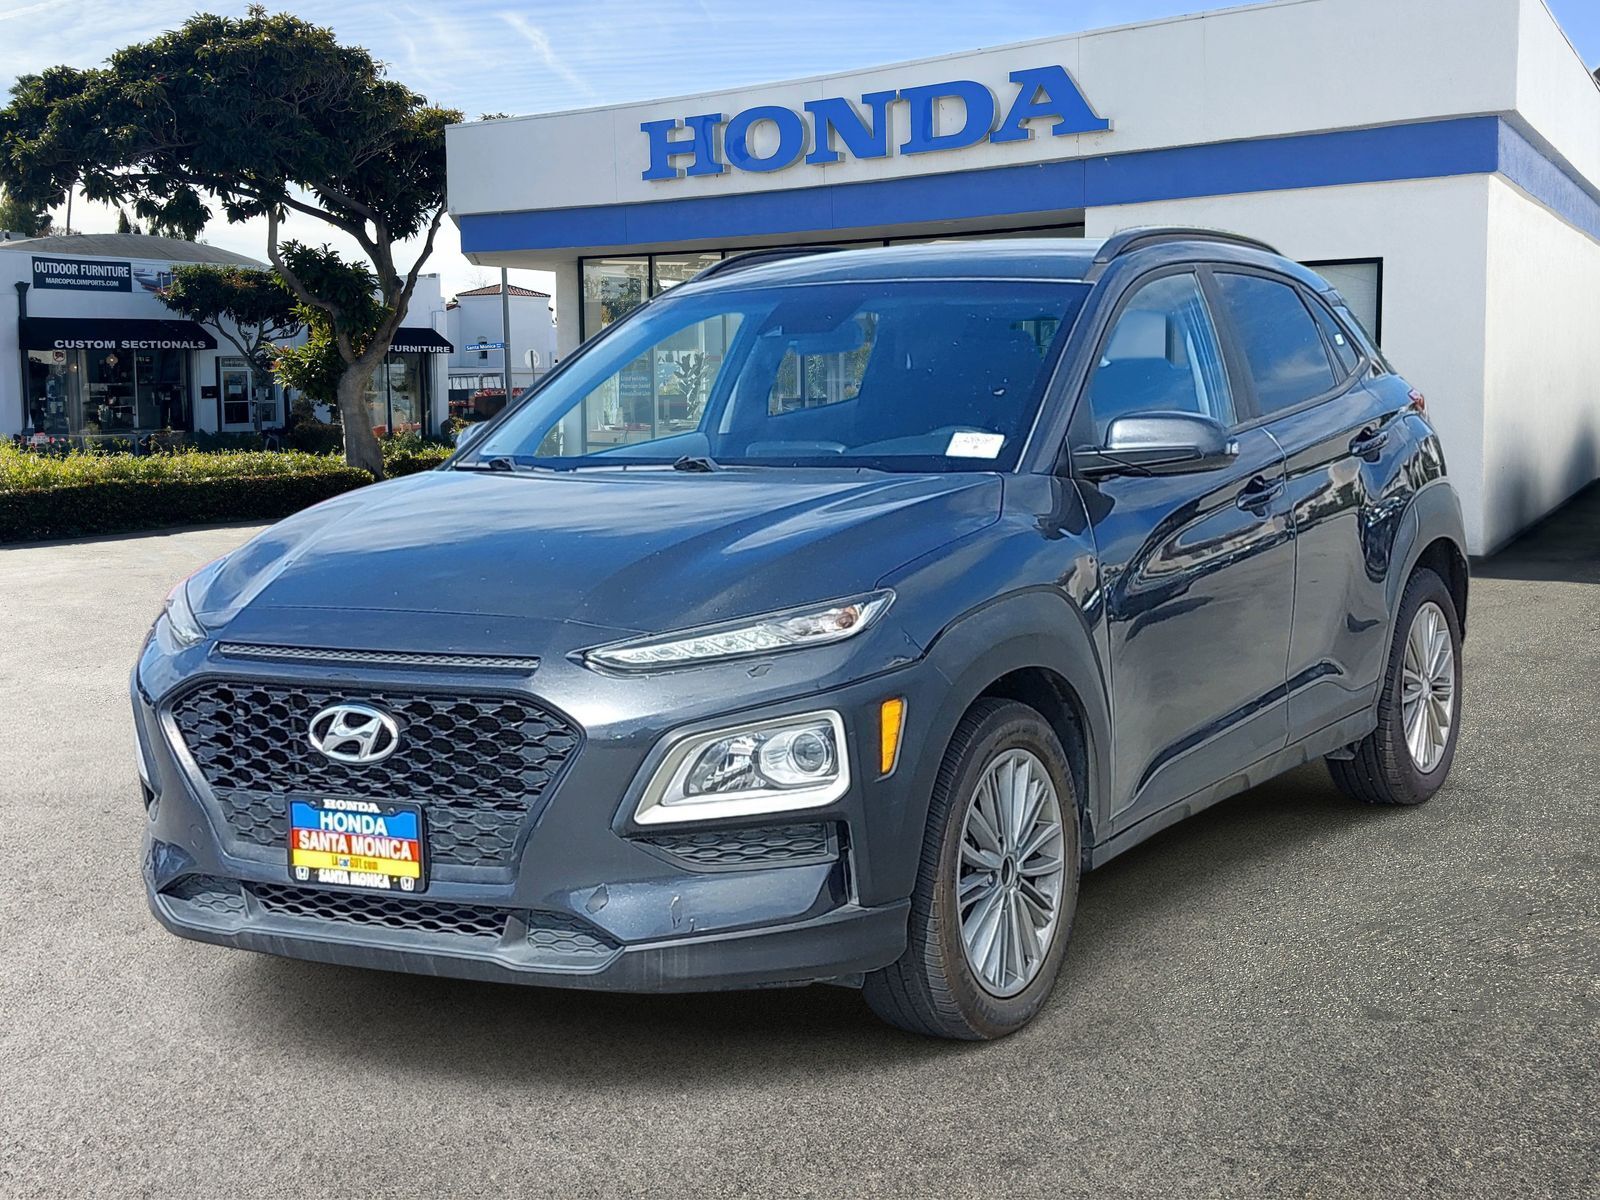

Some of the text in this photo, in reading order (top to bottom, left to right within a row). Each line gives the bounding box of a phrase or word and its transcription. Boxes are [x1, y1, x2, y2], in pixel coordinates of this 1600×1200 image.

[640, 64, 1113, 181] HONDA
[34, 261, 130, 277] OUTDOOR FURNITURE
[45, 277, 119, 287] MARCOPOLOIMPORTS.COM
[54, 339, 206, 349] CUSTOM SECTIONALS
[388, 344, 451, 353] FURNITURE
[322, 799, 381, 813] HONDA
[319, 811, 388, 836] HONDA
[299, 830, 412, 861] SANTA MONICA
[318, 868, 391, 889] SANTA MONICA
